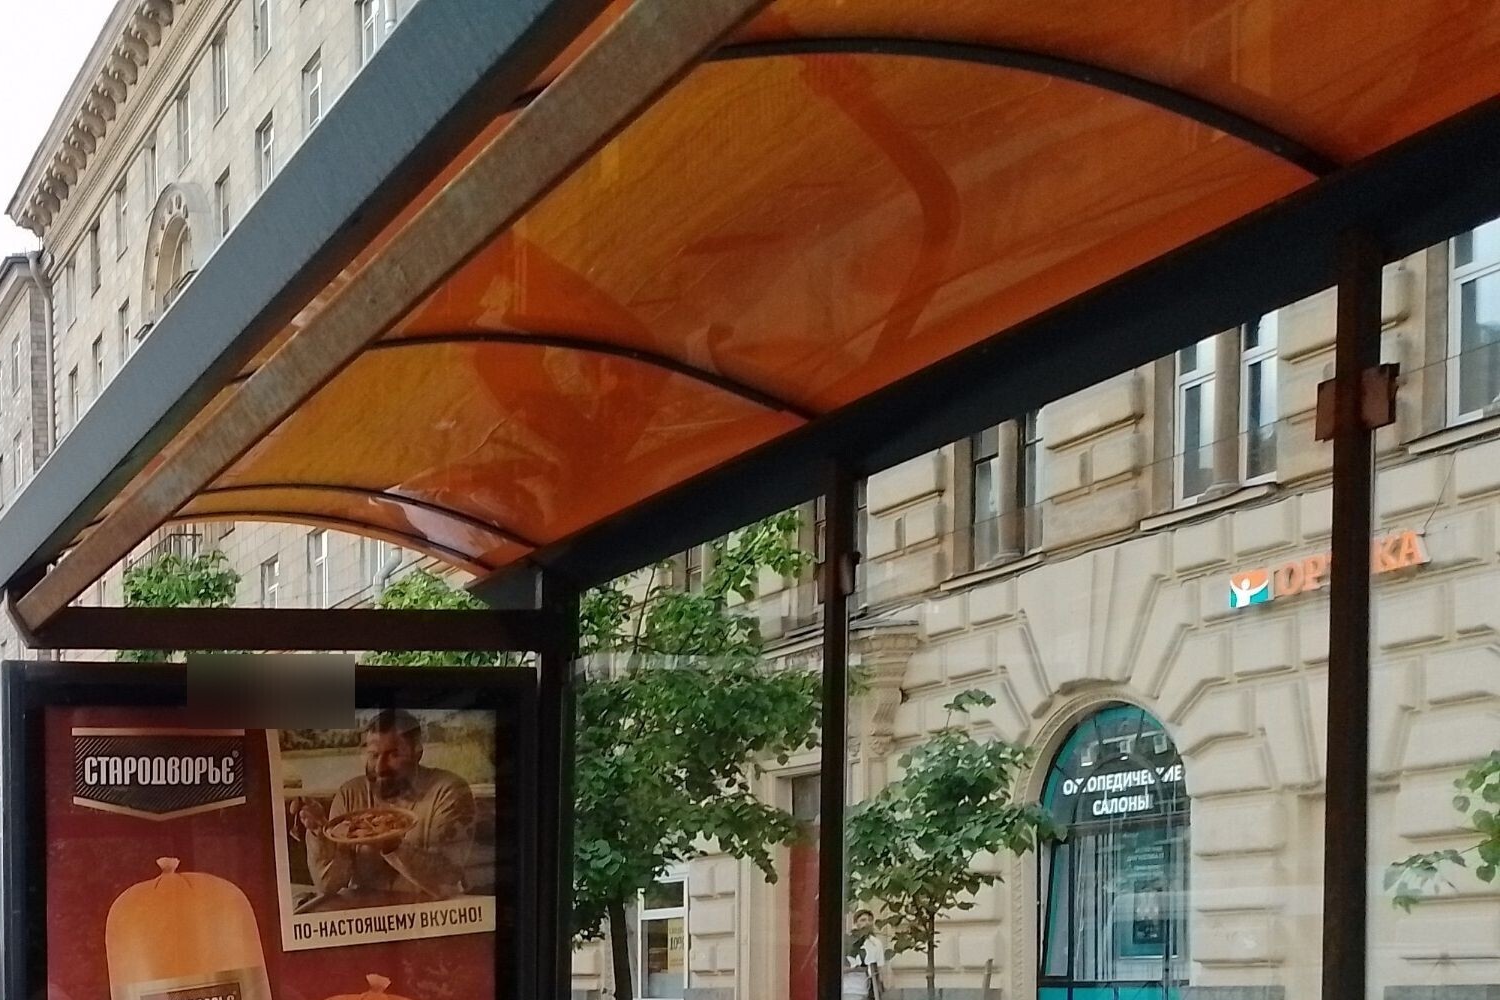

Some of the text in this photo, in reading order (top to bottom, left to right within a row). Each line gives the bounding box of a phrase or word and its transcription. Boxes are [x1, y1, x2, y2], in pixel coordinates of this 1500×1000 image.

[1274, 529, 1424, 597] ОРКА
[1092, 794, 1149, 816] САЛОНЫ
[293, 906, 483, 941] ПО-НАСТОЯЩЕМУ ВКУСНО!
